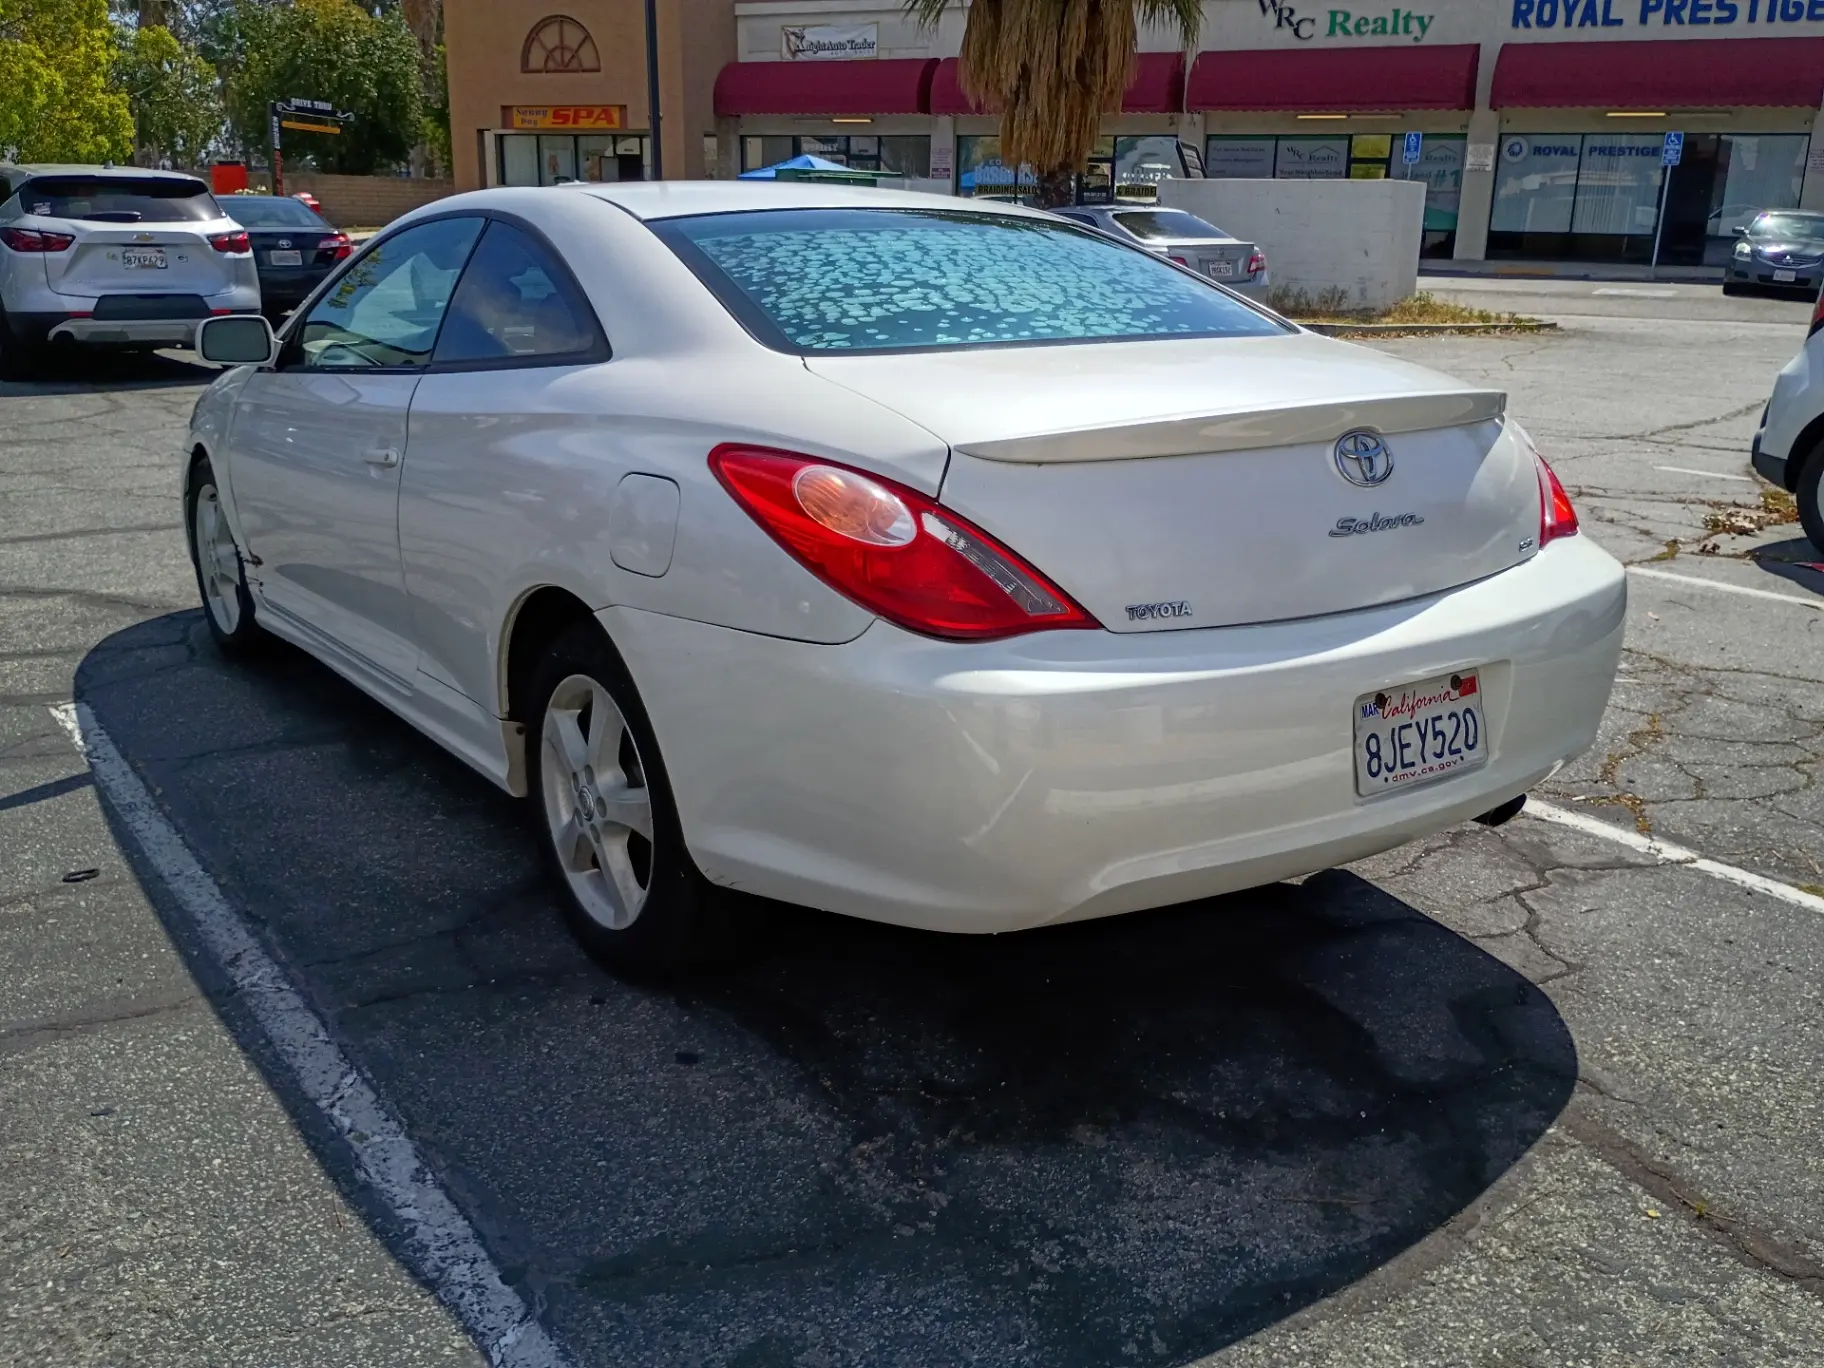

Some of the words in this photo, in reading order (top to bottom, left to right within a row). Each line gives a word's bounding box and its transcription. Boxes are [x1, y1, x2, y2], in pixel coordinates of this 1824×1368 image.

[1257, 0, 1316, 40] WRC
[1325, 8, 1435, 42] Realty
[1511, 0, 1624, 28] ROYAL
[1639, 0, 1824, 26] PRESTIGE
[826, 39, 848, 51] Auto
[848, 37, 876, 50] Trader
[291, 98, 313, 108] DRIVE
[551, 107, 615, 125] SPA
[1309, 154, 1340, 162] Realty
[1532, 145, 1578, 157] ROYAL
[1588, 145, 1661, 157] PRESTIGE
[978, 185, 1014, 194] BRAIDING
[1019, 185, 1038, 194] SALO
[1125, 186, 1157, 196] BRAIDE
[1328, 512, 1425, 537] Solara
[1125, 601, 1192, 620] TOYOTA
[1361, 702, 1379, 718] MAR
[1382, 689, 1459, 719] California
[1365, 707, 1478, 778] 8JEY520
[1391, 759, 1459, 782] dmv.ca.gov
